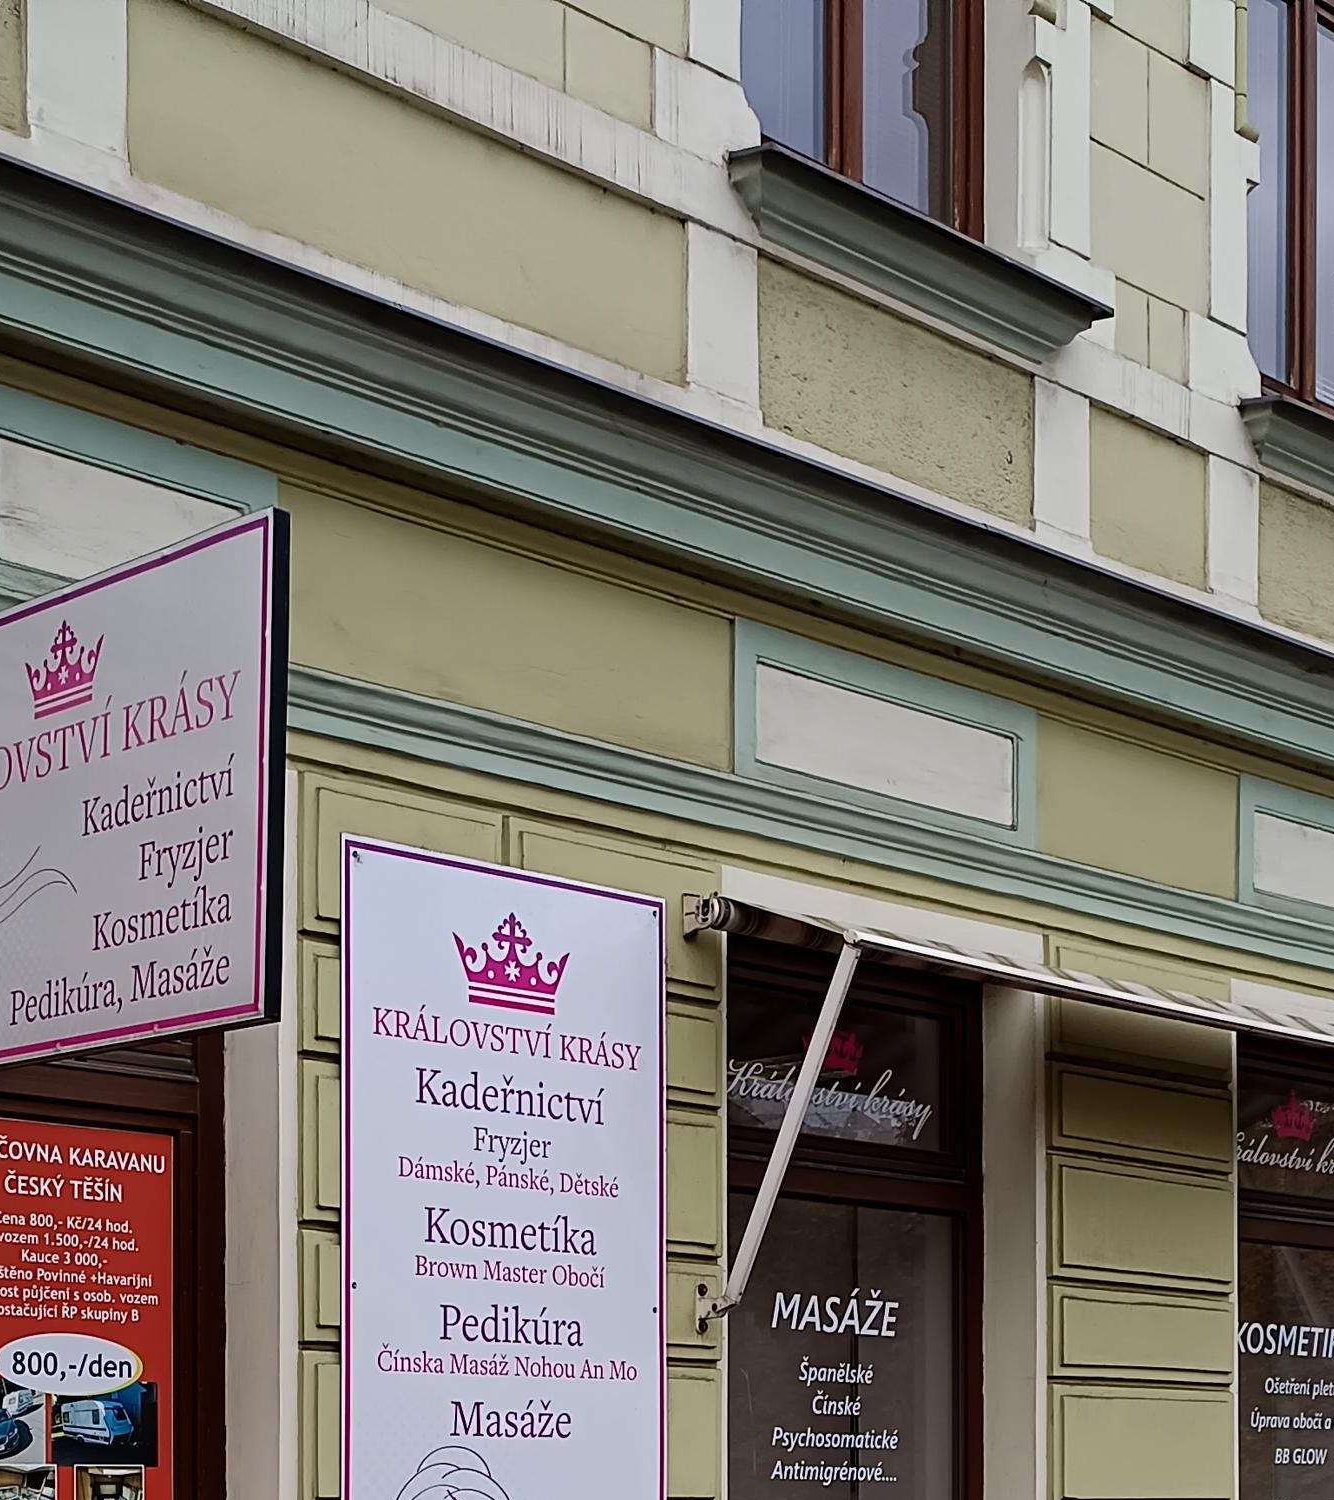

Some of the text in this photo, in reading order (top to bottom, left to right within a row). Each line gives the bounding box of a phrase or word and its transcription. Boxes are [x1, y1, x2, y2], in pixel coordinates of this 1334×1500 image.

[122, 670, 241, 752] KRÁSY
[81, 753, 235, 837] Kadeřnictví
[139, 828, 234, 888] Fryzjer
[10, 944, 230, 1027] Pedikúra, Masáže
[373, 1005, 641, 1071] KRÁLOVSTVÍ KRÁSY
[416, 1067, 605, 1125] Kadeřnictví
[726, 1059, 932, 1140] Králství krásy
[69, 1147, 165, 1173] KARAVANU
[474, 1127, 551, 1164] Fryzjer
[4, 1169, 122, 1202] ČESKÝ TĚŠÍN
[398, 1156, 619, 1198] Dámské, Pánské, Dětské
[30, 1214, 63, 1230] 800,-
[67, 1215, 102, 1231] Kč/24
[106, 1219, 132, 1234] hod.
[425, 1206, 597, 1256] Kosmetíka
[22, 1249, 108, 1268] Kauce 3 000,-
[44, 1233, 108, 1249] 1.500,-/24
[113, 1237, 139, 1251] hod.
[37, 1268, 86, 1283] Povinné
[415, 1255, 605, 1288] Brown Master Obočí
[23, 1285, 69, 1301] půjčení
[74, 1290, 79, 1299] s
[83, 1290, 115, 1302] osob.
[120, 1292, 158, 1305] vozem
[62, 1303, 77, 1318] ŘP
[81, 1306, 127, 1323] skupiny
[131, 1309, 139, 1321] B
[440, 1304, 583, 1347] Pedikúra
[771, 1288, 899, 1337] MASÁŽE
[12, 1351, 132, 1381] 800,-/den
[377, 1343, 637, 1381] Čínska Masáž Nohou An Mo
[799, 1356, 873, 1386] Španělské
[1265, 1377, 1310, 1395] Ošetření
[450, 1399, 571, 1438] Masáže
[812, 1390, 861, 1416] Čínské
[1251, 1407, 1290, 1432] Úprava
[1293, 1412, 1322, 1430] obočí
[1325, 1417, 1332, 1430] a
[771, 1426, 899, 1452] Psychosomatické
[1275, 1448, 1328, 1465] BB GLOW
